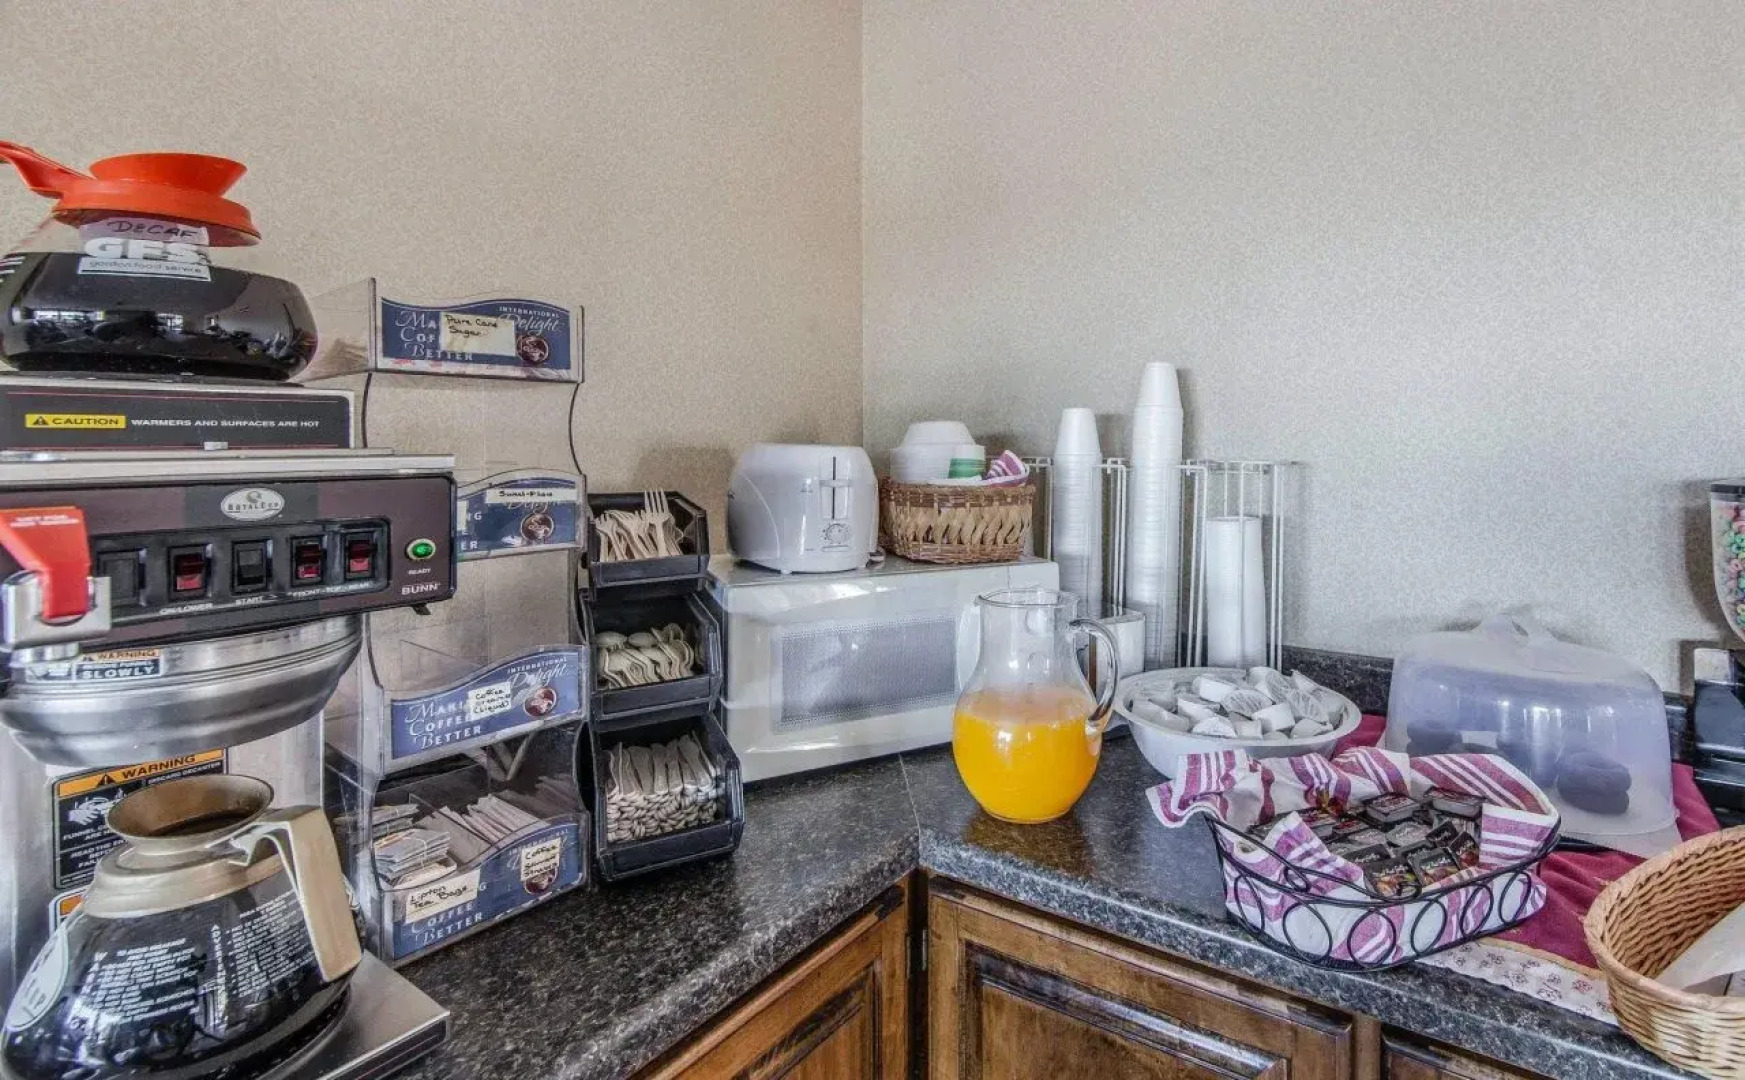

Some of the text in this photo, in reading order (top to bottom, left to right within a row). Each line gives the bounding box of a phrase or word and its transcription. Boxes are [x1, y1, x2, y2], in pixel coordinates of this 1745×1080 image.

[107, 220, 198, 237] DECAF
[499, 306, 560, 318] INTERNATIONAL
[52, 417, 119, 426] CAUTION
[300, 420, 320, 428] HOT
[402, 582, 438, 595] BUNN
[82, 666, 154, 679] SLOWLY
[507, 656, 567, 674] INTERNATIONAL
[413, 725, 481, 748] BETTER
[121, 753, 196, 780] WARNING
[415, 911, 483, 946] BETTER
